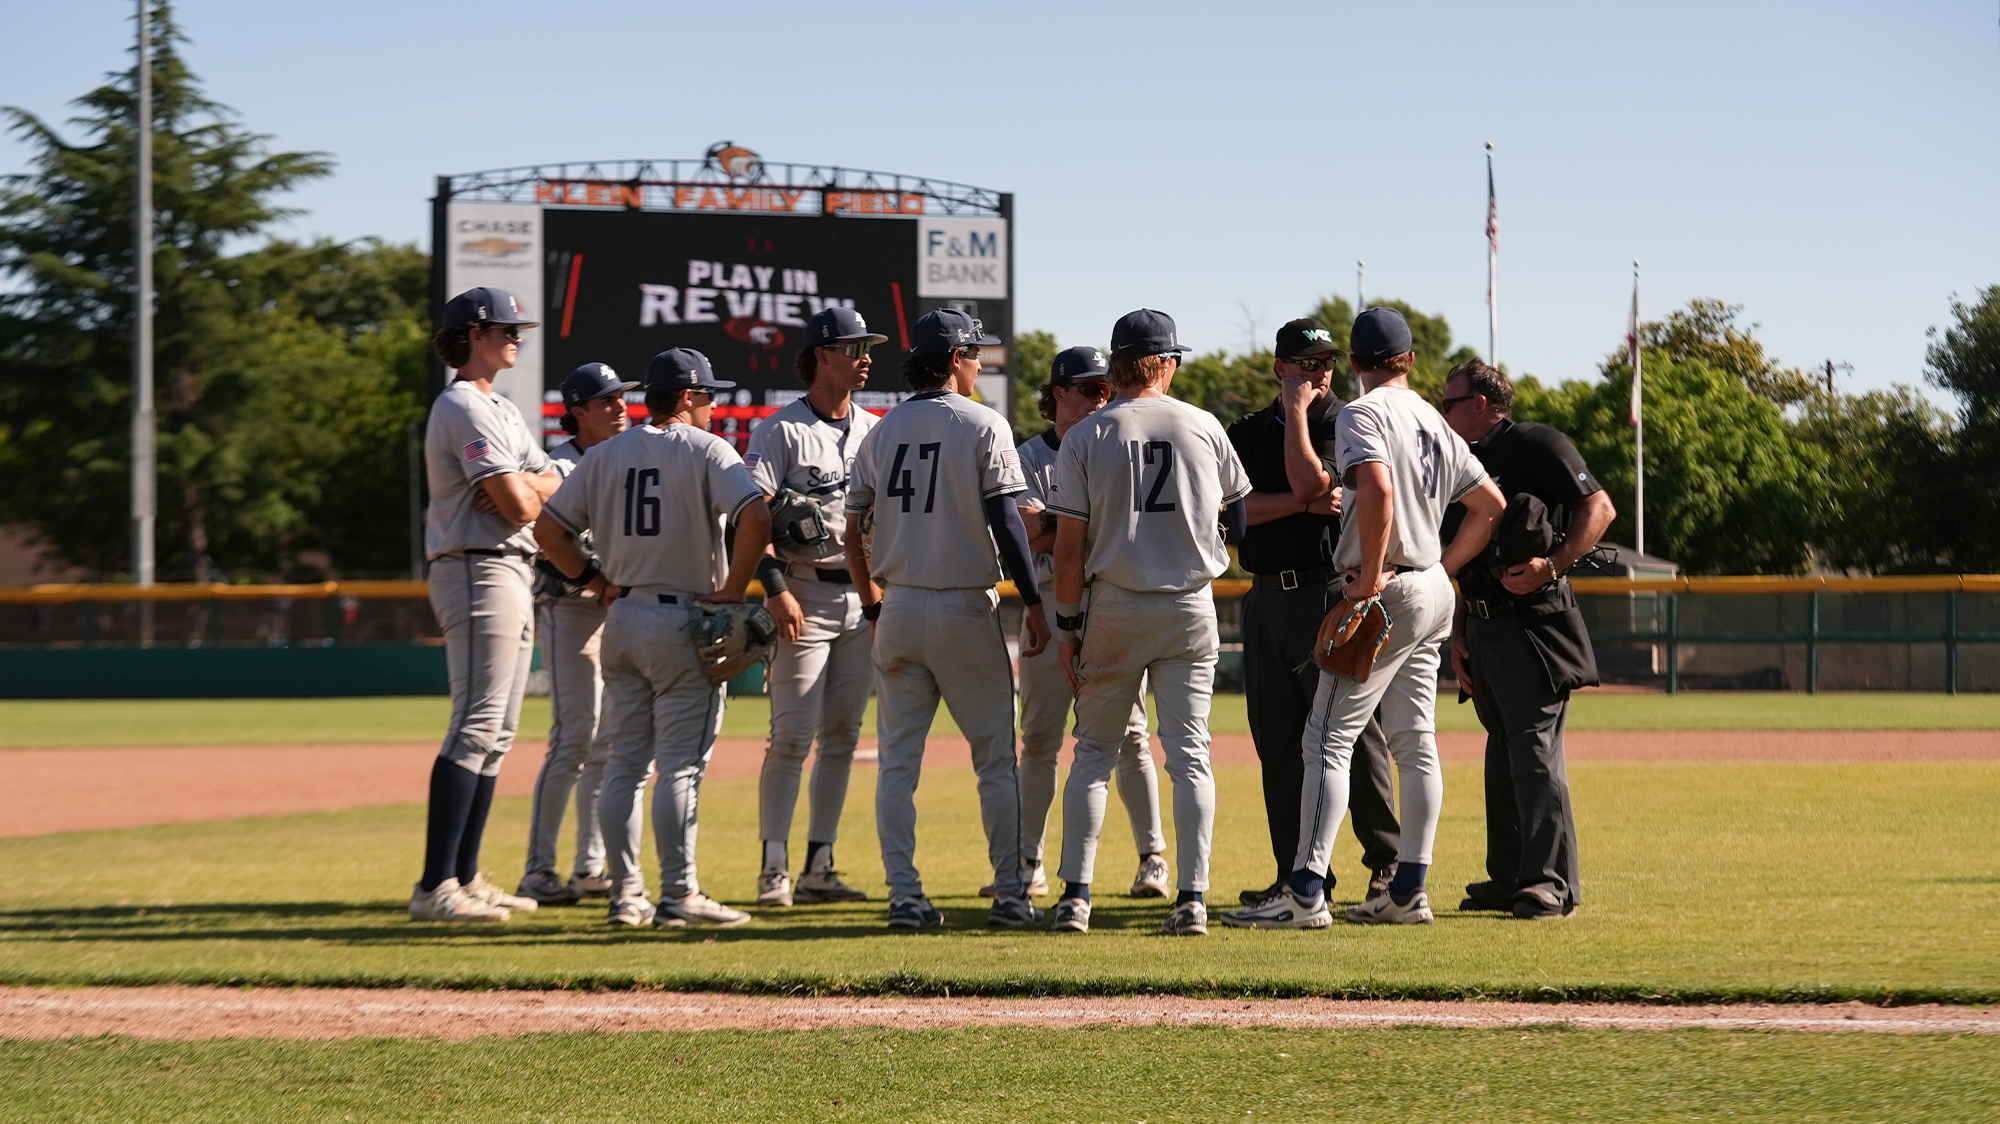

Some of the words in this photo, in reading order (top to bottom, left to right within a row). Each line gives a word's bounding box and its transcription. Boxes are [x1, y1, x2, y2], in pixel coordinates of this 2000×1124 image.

[536, 183, 642, 208] KLEIN
[674, 187, 802, 212] FAMILY
[825, 192, 924, 214] FIELD
[456, 219, 534, 235] CHASE
[926, 229, 997, 258] F&M
[687, 258, 775, 291] PLAY
[782, 267, 818, 295] IN
[926, 263, 998, 285] BANK
[807, 466, 840, 487] San
[887, 441, 941, 514] 47
[1130, 440, 1176, 513] 12
[624, 467, 661, 537] 16
